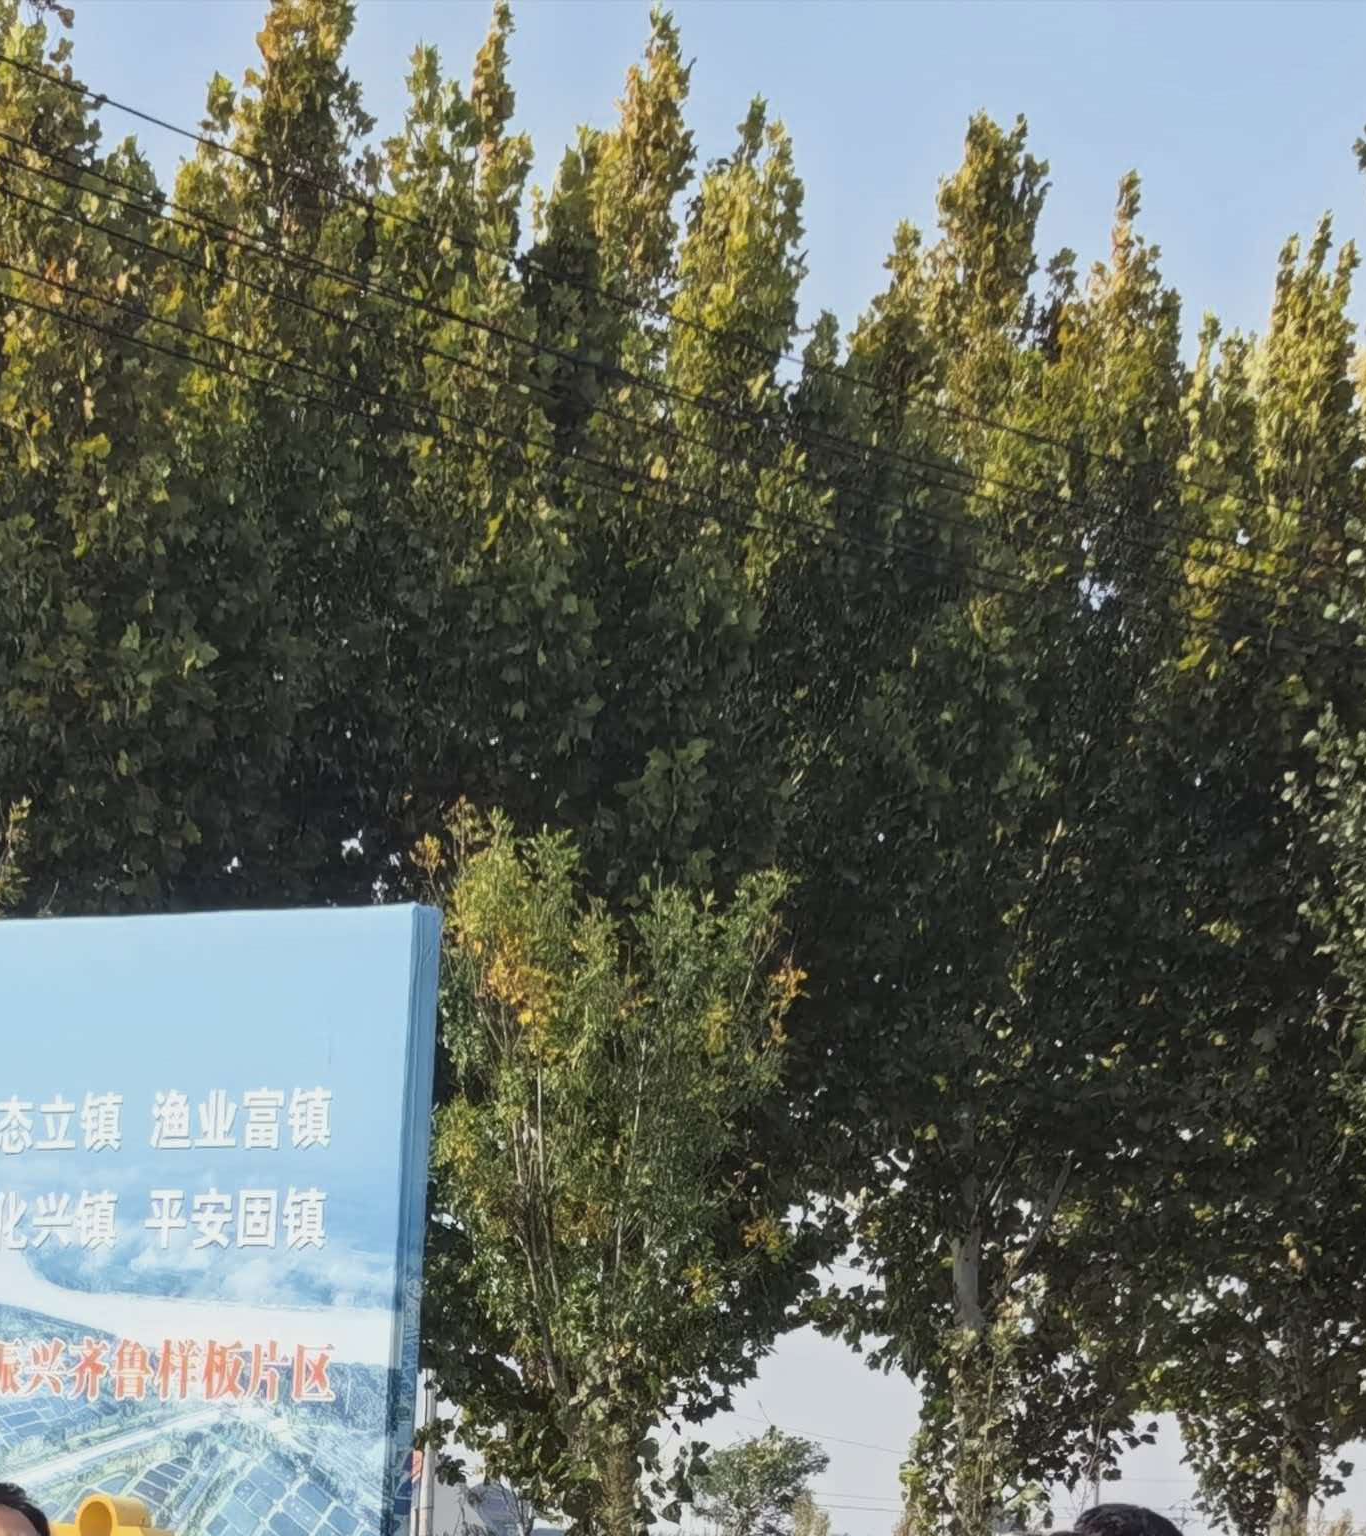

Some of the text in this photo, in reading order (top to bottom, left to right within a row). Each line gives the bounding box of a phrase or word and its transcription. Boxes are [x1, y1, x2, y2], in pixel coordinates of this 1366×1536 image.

[150, 1086, 333, 1151] 渔业富镇
[145, 1184, 328, 1250] 平安固镇
